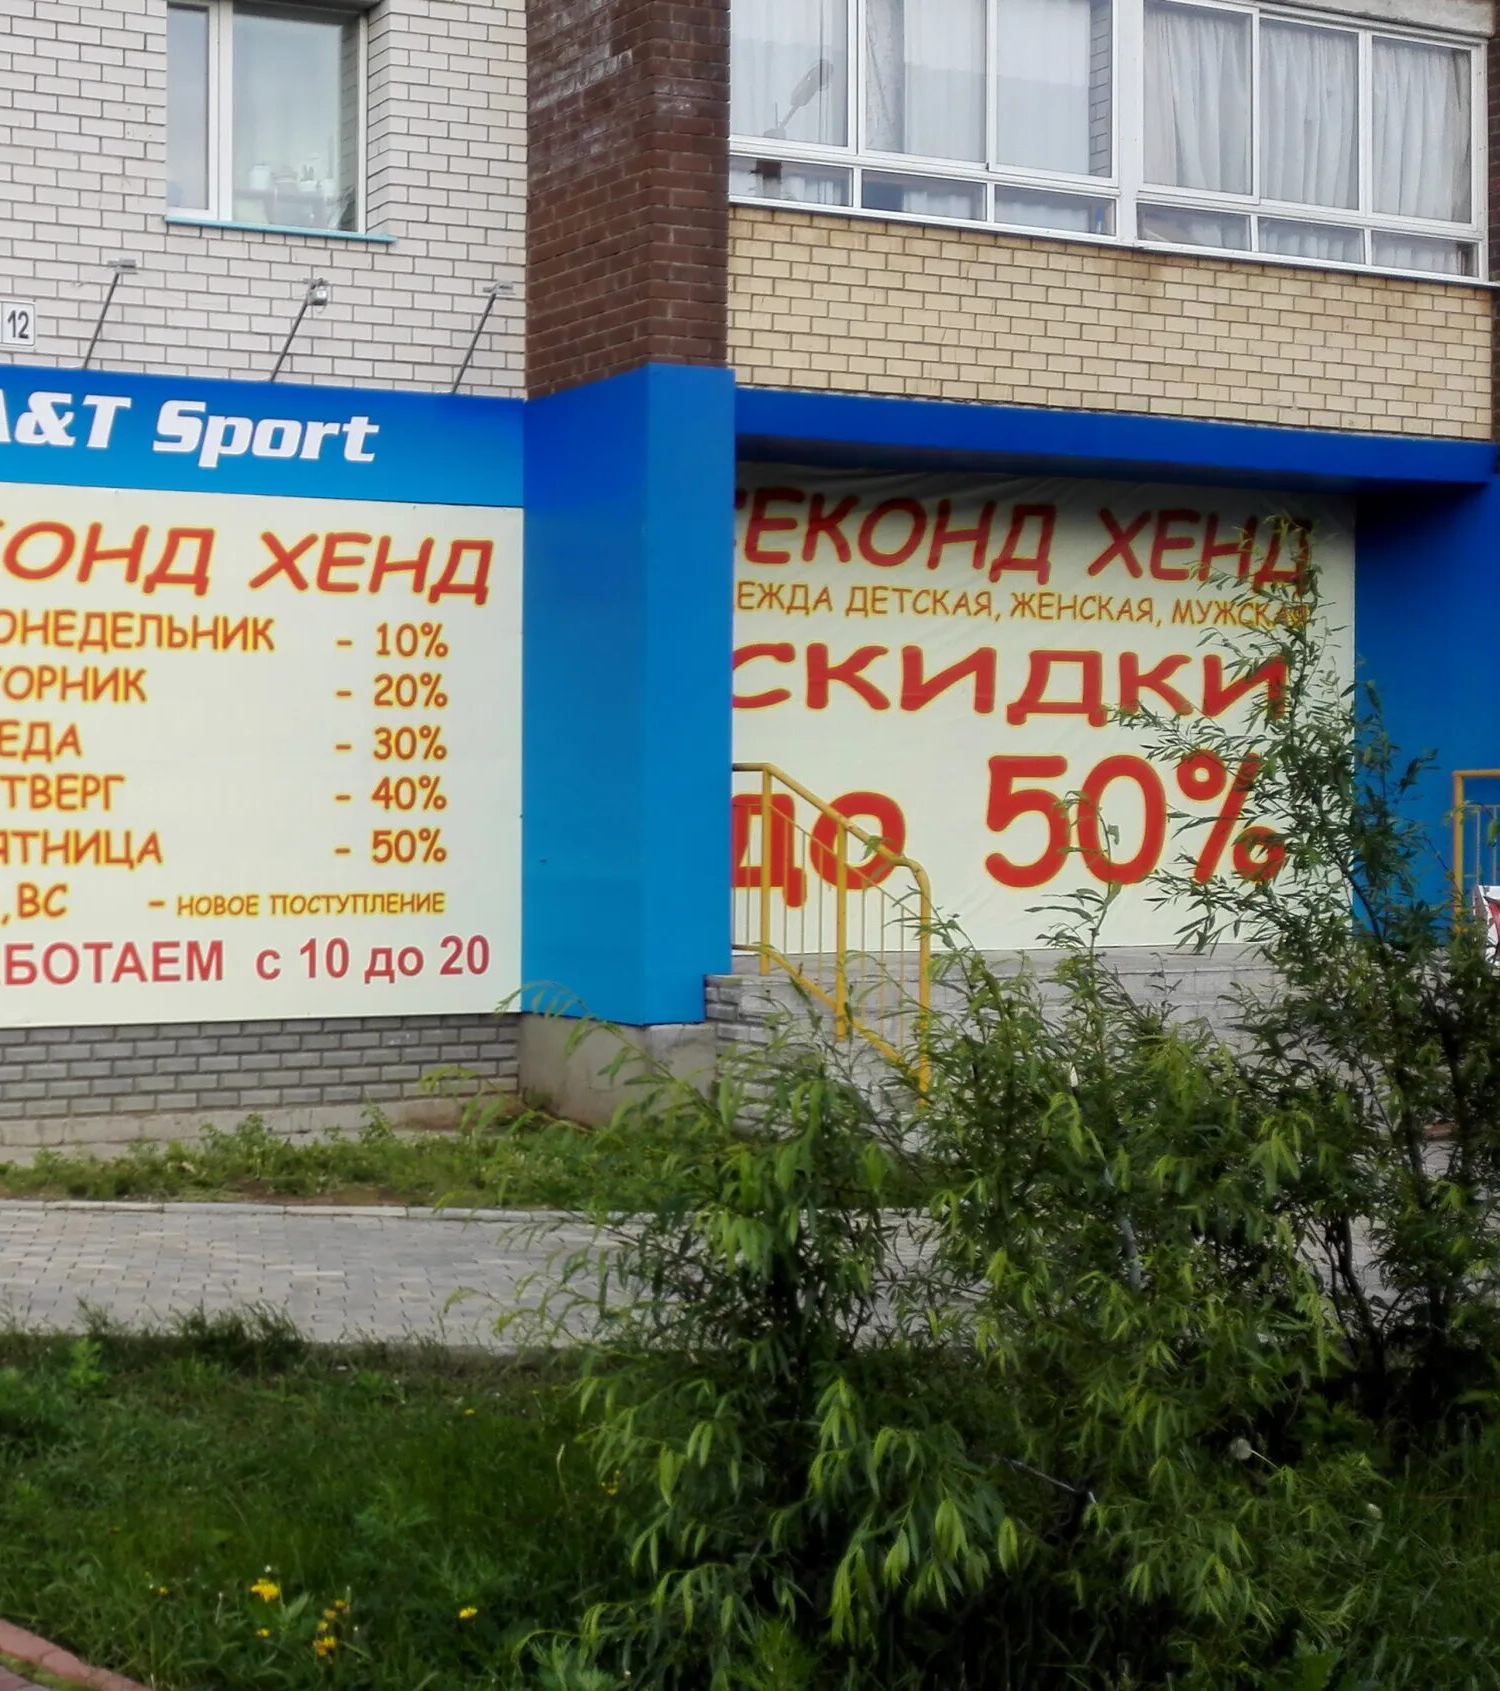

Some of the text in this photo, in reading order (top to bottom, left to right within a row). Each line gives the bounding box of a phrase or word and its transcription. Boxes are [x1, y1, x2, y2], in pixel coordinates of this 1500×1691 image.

[7, 310, 30, 339] 12
[152, 400, 380, 467] Sport
[735, 486, 1314, 597] ЕКОНД ХЕНД
[246, 531, 494, 606] ХЕНД
[845, 585, 1002, 622] ДЕТСКАЯ,
[1009, 590, 1162, 628] ЖЕНСКАЯ,
[375, 621, 449, 659] 10%
[372, 672, 448, 709] 20%
[372, 724, 447, 761] 30%
[371, 774, 448, 812] 40%
[985, 749, 1286, 888] 50%
[371, 827, 447, 865] 50%
[176, 894, 259, 917] НОВОЕ
[269, 891, 444, 916] ПОСТУПЛЕНИЕ
[300, 938, 350, 979] 10
[363, 947, 424, 984] до
[440, 935, 490, 976] 20
